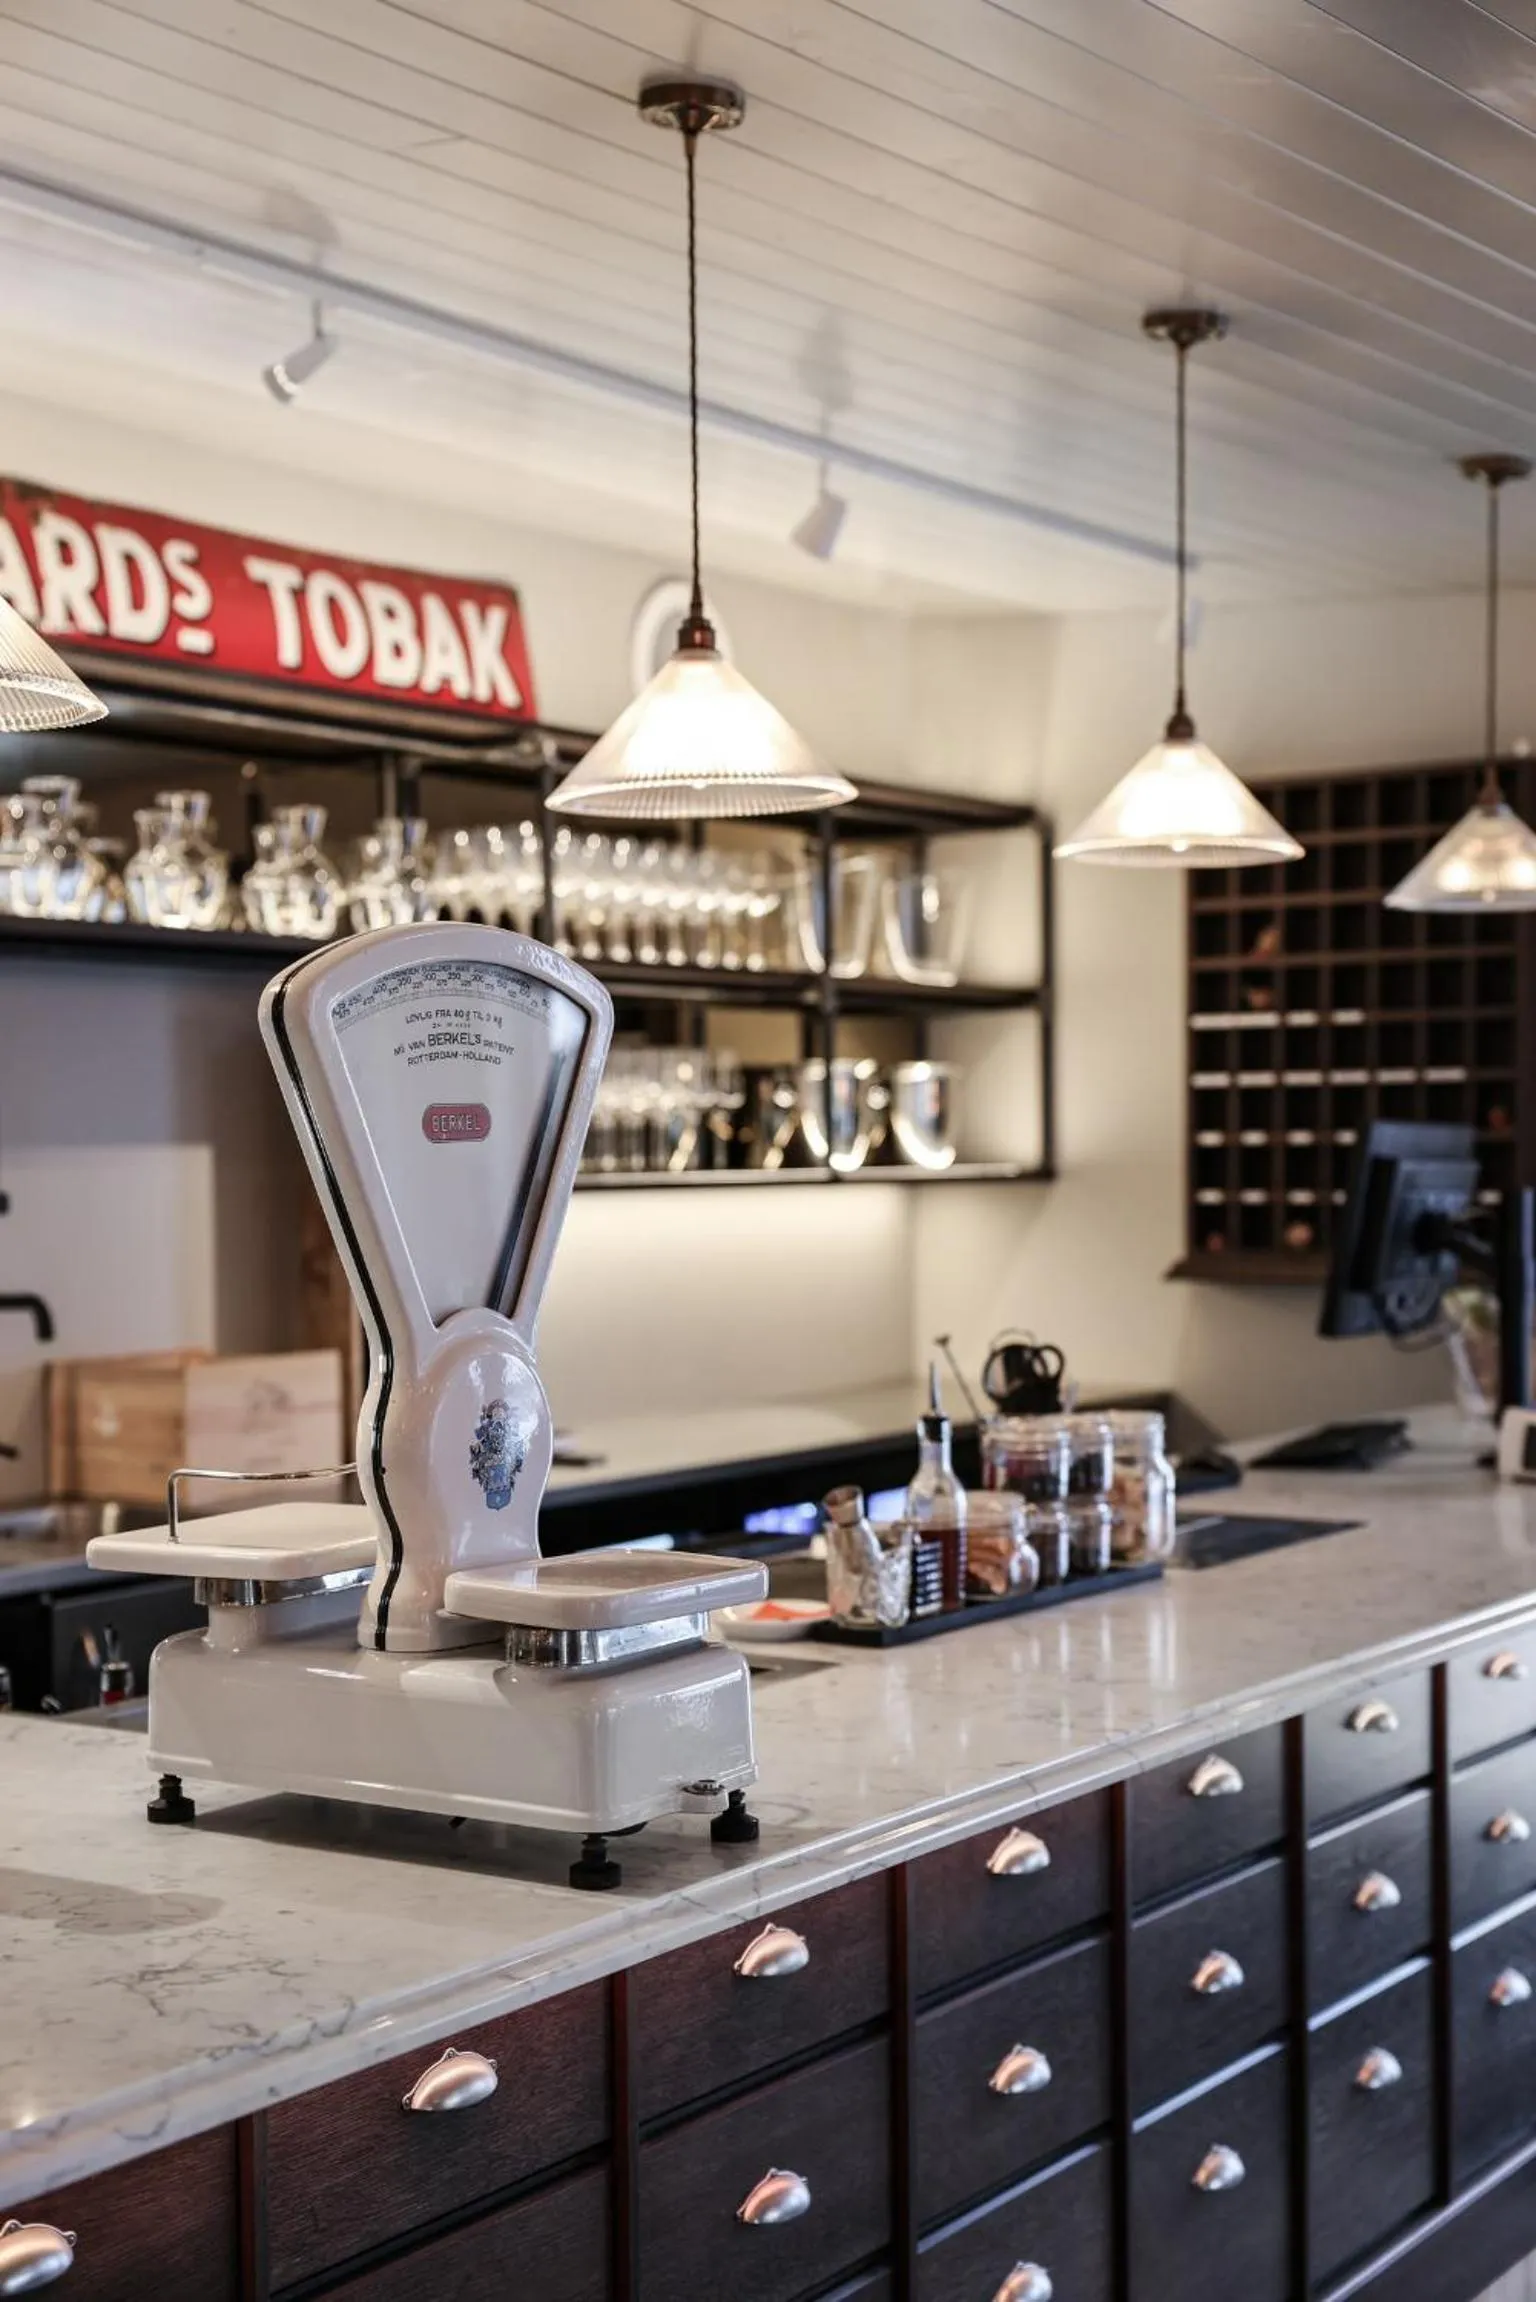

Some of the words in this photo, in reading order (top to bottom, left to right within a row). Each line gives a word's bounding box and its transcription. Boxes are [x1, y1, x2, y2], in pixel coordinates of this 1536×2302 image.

[244, 555, 523, 709] TOBAK
[435, 1009, 452, 1018] FRA
[408, 1039, 427, 1051] VAN
[432, 1114, 481, 1132] BERKEL
